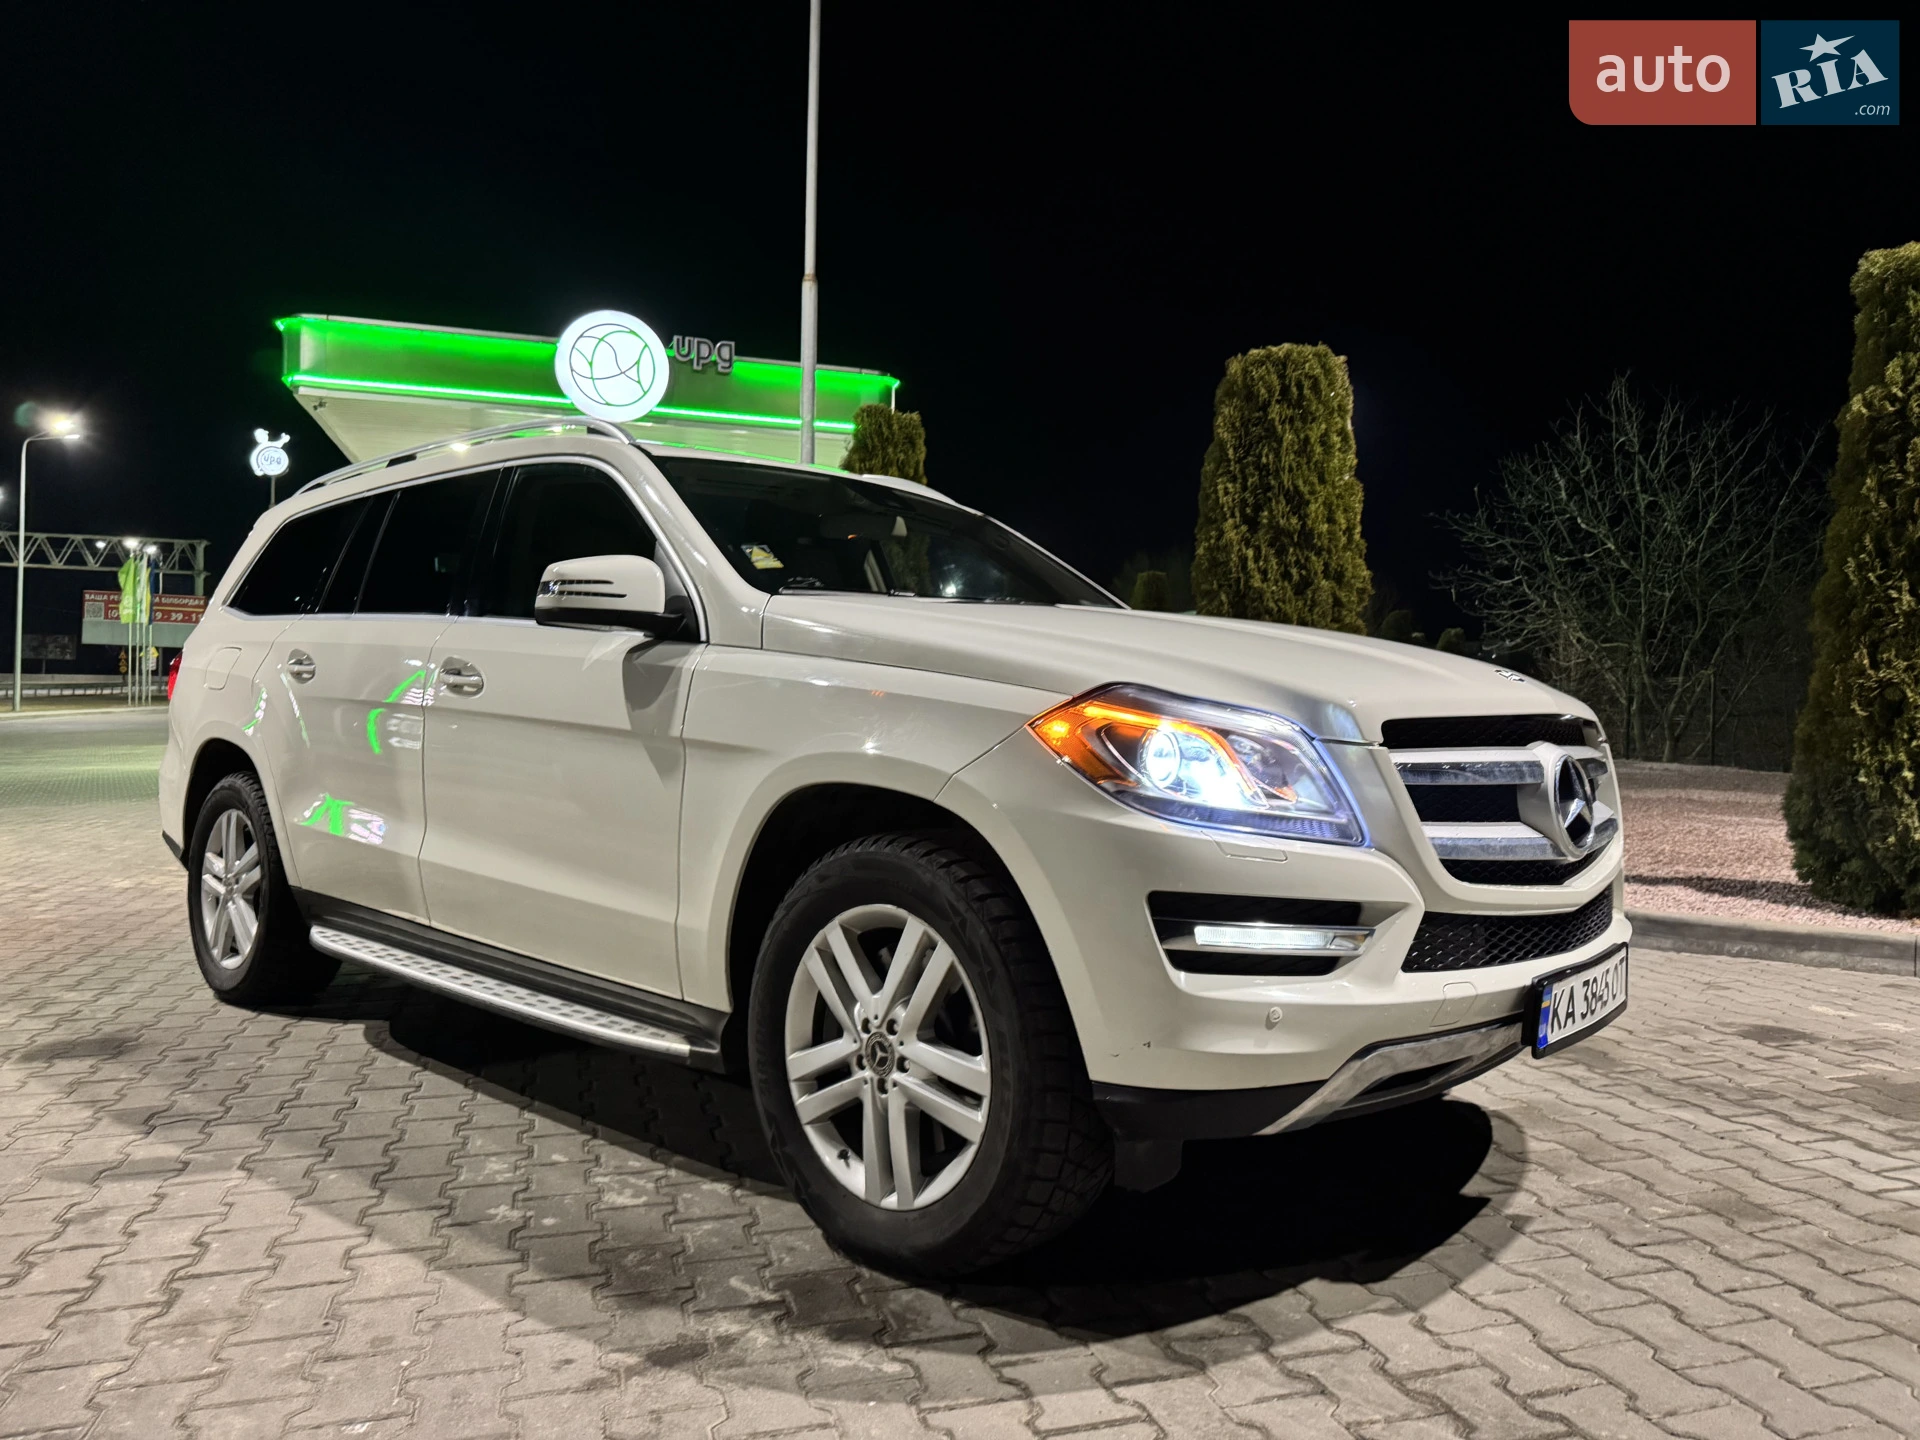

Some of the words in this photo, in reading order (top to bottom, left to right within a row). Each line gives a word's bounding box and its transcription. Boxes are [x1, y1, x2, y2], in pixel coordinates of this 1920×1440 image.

[673, 335, 735, 373] upg
[1551, 985, 1576, 1034] KA
[1581, 968, 1610, 1020] 3845
